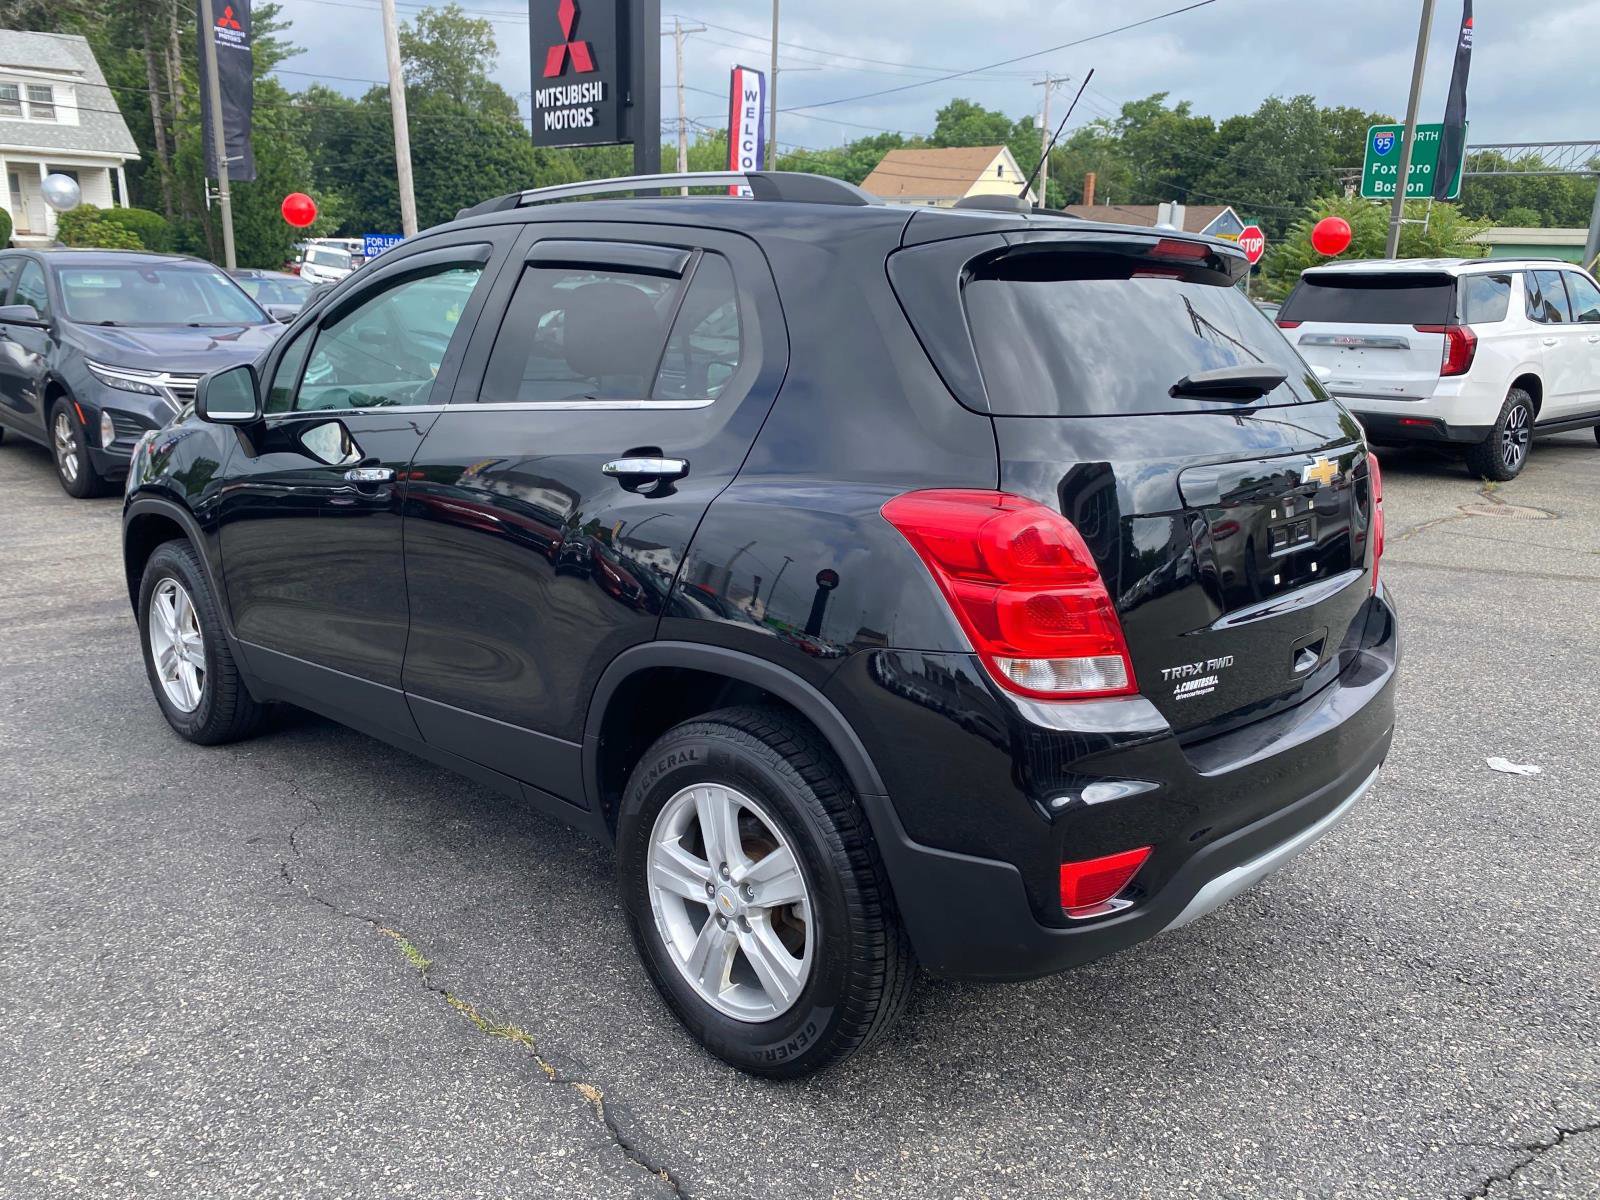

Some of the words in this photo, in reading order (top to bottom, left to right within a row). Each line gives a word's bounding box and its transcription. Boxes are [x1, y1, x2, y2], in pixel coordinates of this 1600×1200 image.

[536, 81, 602, 108] MITSUBISHI
[544, 108, 593, 131] MOTORS
[742, 90, 758, 196] WELCO
[1376, 138, 1391, 150] 95
[1371, 162, 1431, 175] Foxoro
[1373, 180, 1424, 193] Boson
[366, 238, 383, 247] FOR
[1240, 238, 1262, 253] STOP
[1160, 661, 1204, 681] TRAX
[1205, 655, 1234, 672] AWD
[635, 749, 698, 799] GENERAL
